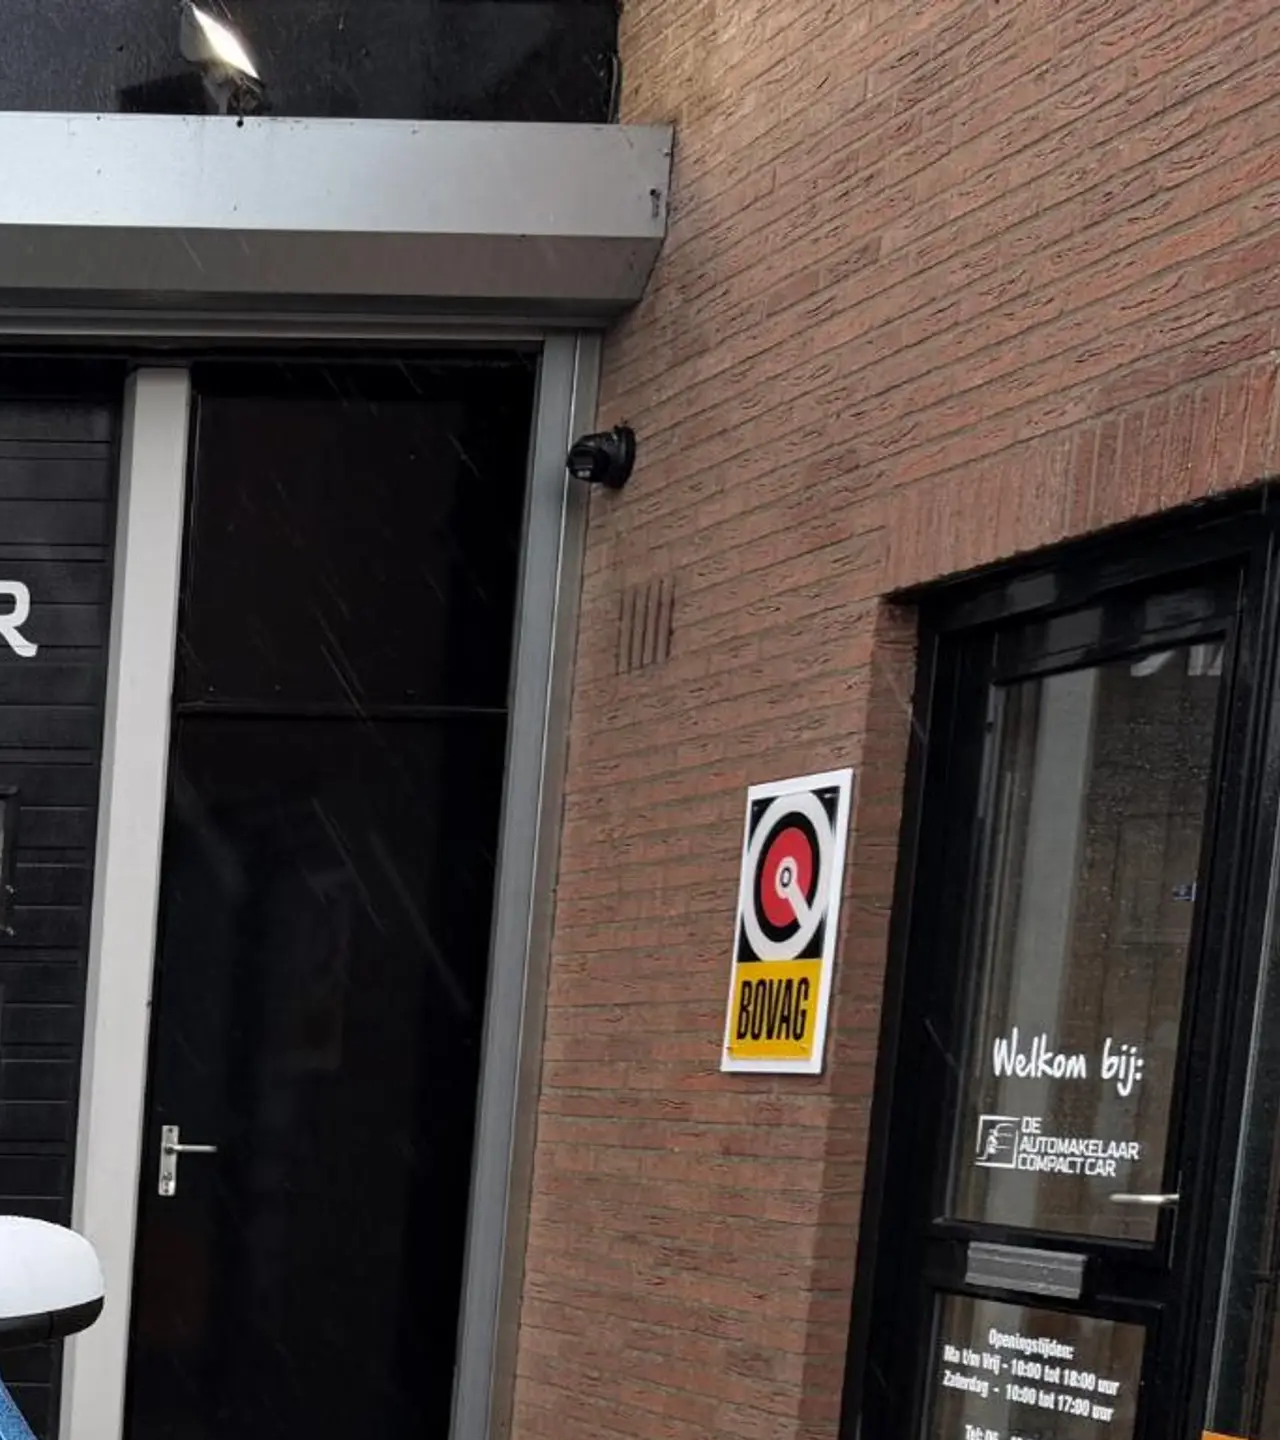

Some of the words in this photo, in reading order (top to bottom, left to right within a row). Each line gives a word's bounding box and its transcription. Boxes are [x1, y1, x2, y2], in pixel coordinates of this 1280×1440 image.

[737, 977, 809, 1040] BOVAG
[994, 1027, 1086, 1078] Welkom
[1102, 1038, 1143, 1096] bij:
[1022, 1117, 1041, 1133] DE
[1019, 1135, 1140, 1161] AUTOMAKELAAR
[1017, 1153, 1085, 1174] COMPACT
[1085, 1158, 1116, 1176] CAR
